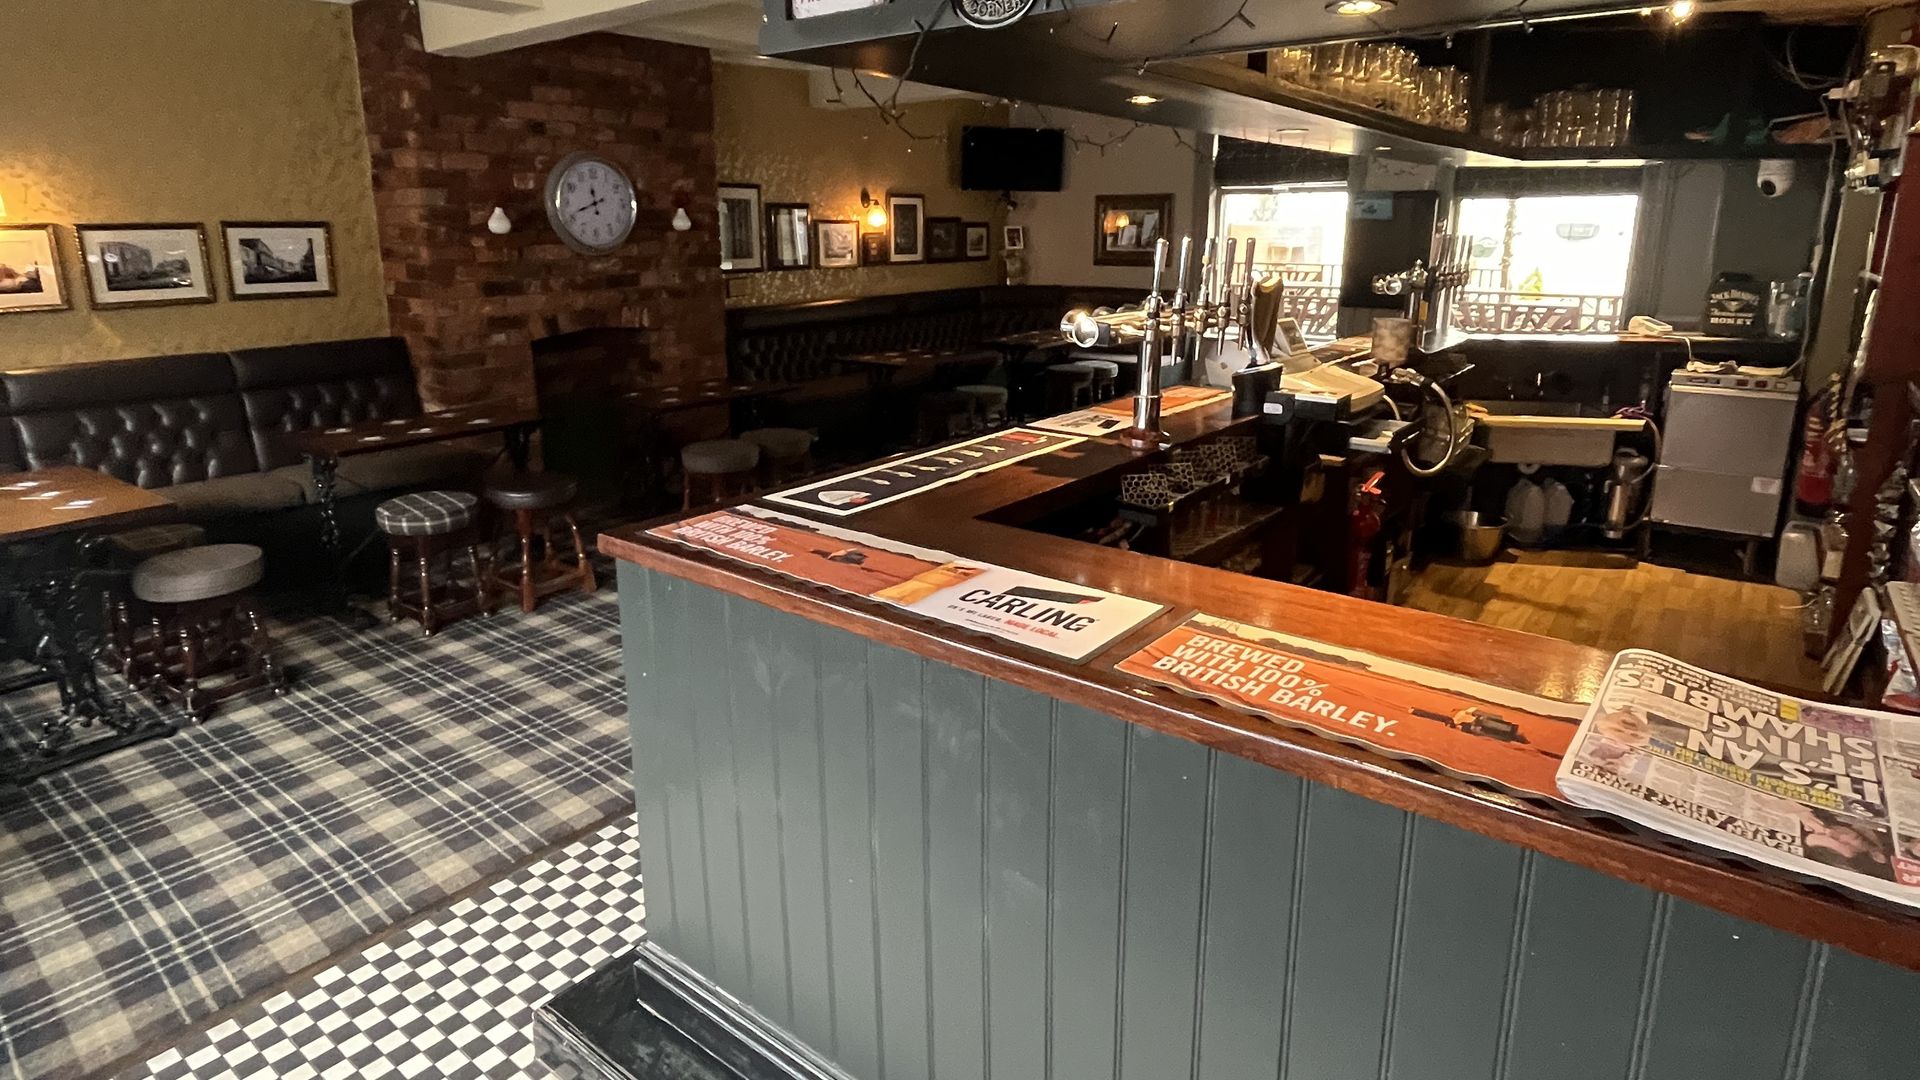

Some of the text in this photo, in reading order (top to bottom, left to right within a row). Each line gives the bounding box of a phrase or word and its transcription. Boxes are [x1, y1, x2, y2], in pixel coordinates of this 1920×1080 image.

[1710, 317, 1753, 326] HONEY
[672, 525, 794, 563] BRITISH BARLEY.
[693, 520, 738, 535] WITH
[712, 514, 778, 534] BREWED
[958, 589, 1096, 633] CARLING
[1172, 644, 1331, 698] WITH 100%
[1186, 634, 1305, 674] BREWED
[1152, 656, 1399, 738] BRITISH BARLEY.
[1612, 668, 1876, 761] SHAMBLES
[1685, 727, 1764, 771] AN
[1572, 767, 1646, 801] PRIMED
[1780, 760, 1881, 806] IT'S
[1725, 822, 1804, 857] BEATEN
